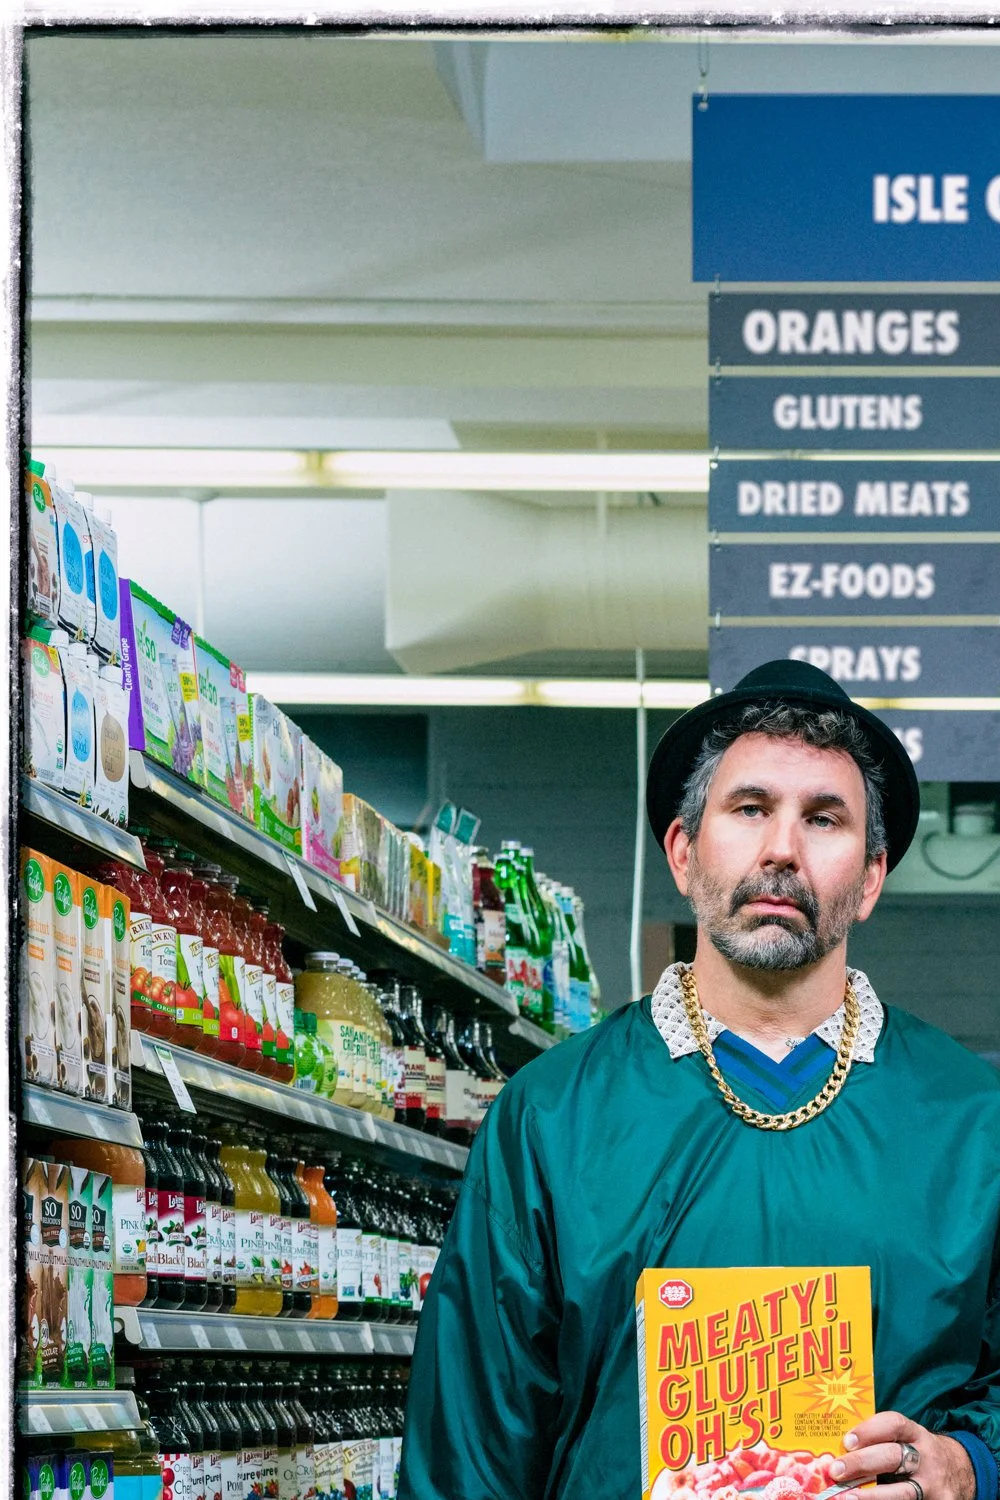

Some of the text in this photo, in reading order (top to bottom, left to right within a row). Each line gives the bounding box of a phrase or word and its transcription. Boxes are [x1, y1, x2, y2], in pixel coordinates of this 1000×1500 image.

[872, 174, 968, 224] ISLE
[743, 309, 959, 355] ORANGES
[773, 394, 922, 430] GLUTENS
[738, 481, 969, 516] DRIED MEATS
[769, 563, 935, 599] EZ-FOODS
[121, 637, 132, 692] Clearly Grape
[44, 1201, 57, 1216] SO
[71, 1204, 81, 1220] SO
[120, 1218, 140, 1230] PINK
[158, 1253, 180, 1265] Black
[658, 1272, 838, 1371] MEATY!
[658, 1320, 852, 1421] GLUTEN!
[658, 1386, 784, 1472] OH'S!
